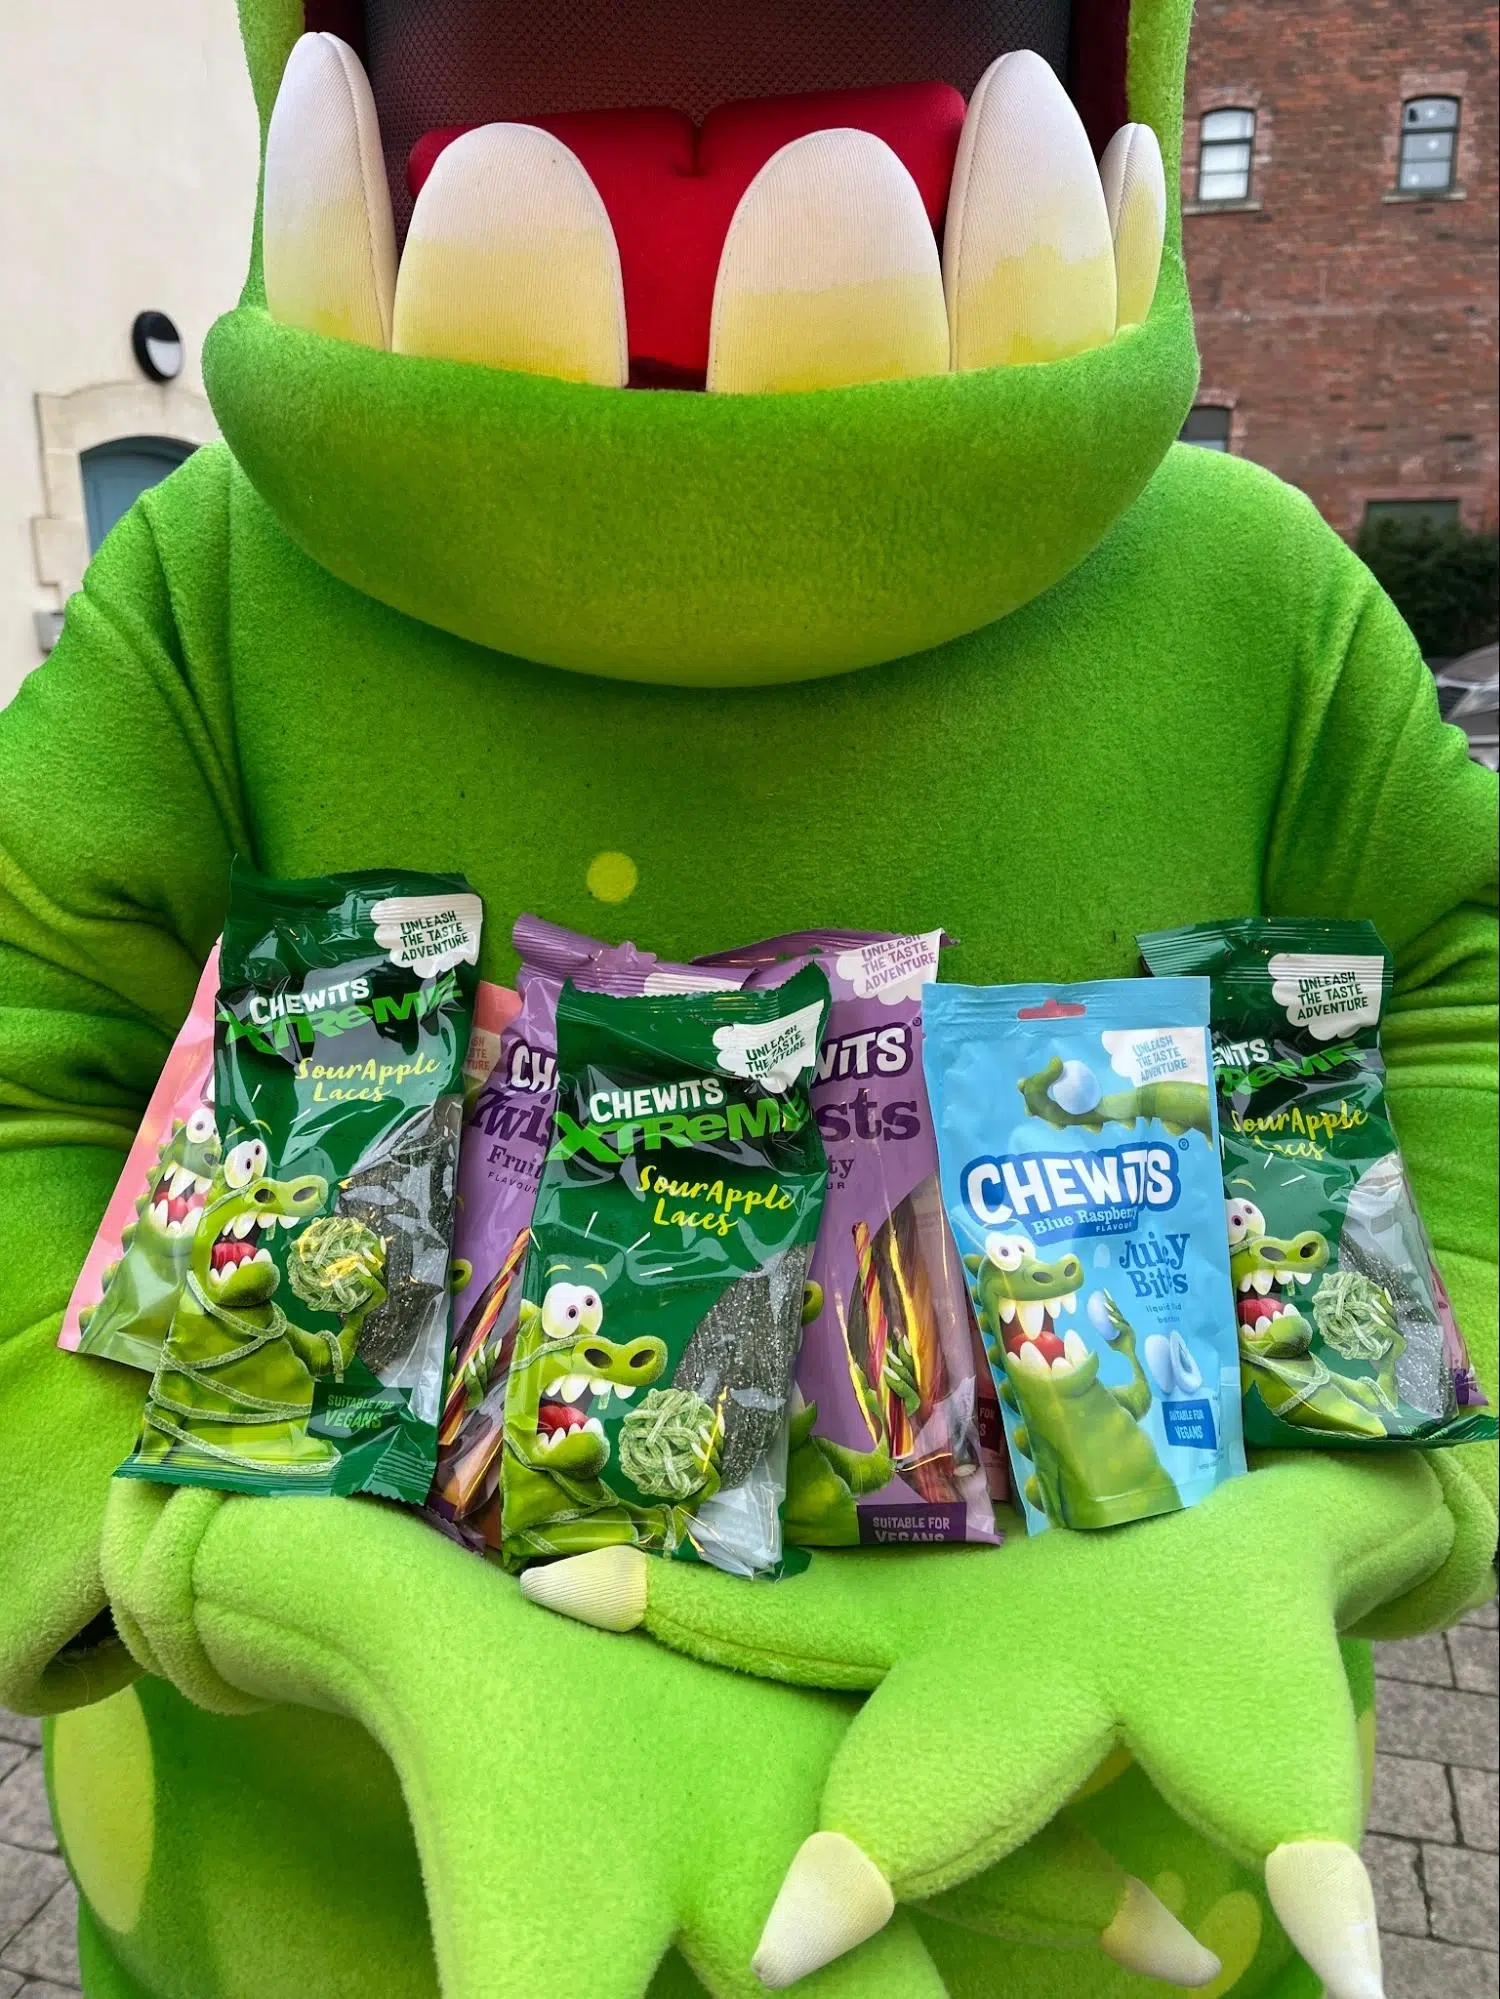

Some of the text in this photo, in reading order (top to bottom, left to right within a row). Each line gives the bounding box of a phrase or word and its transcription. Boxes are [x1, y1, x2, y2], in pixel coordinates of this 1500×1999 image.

[400, 910, 457, 935] UNLEASH
[400, 922, 464, 948] THE TASTE
[400, 932, 470, 962] ADVENTURE
[862, 941, 929, 975] THE TASTE
[864, 952, 937, 992] ADVENTURE
[1298, 971, 1356, 993] UNLEASH
[1298, 983, 1363, 1007] THE TASTE
[1297, 996, 1369, 1021] ADVENTURE
[745, 1058, 769, 1073] THE
[1136, 1047, 1182, 1068] THE TASTE
[1140, 1058, 1188, 1082] ADVENTURE
[313, 1082, 392, 1103] Laces
[654, 1198, 738, 1236] Laces
[1031, 1215, 1074, 1236] Blue
[324, 1409, 383, 1429] VEGANS
[928, 1516, 950, 1530] FOR
